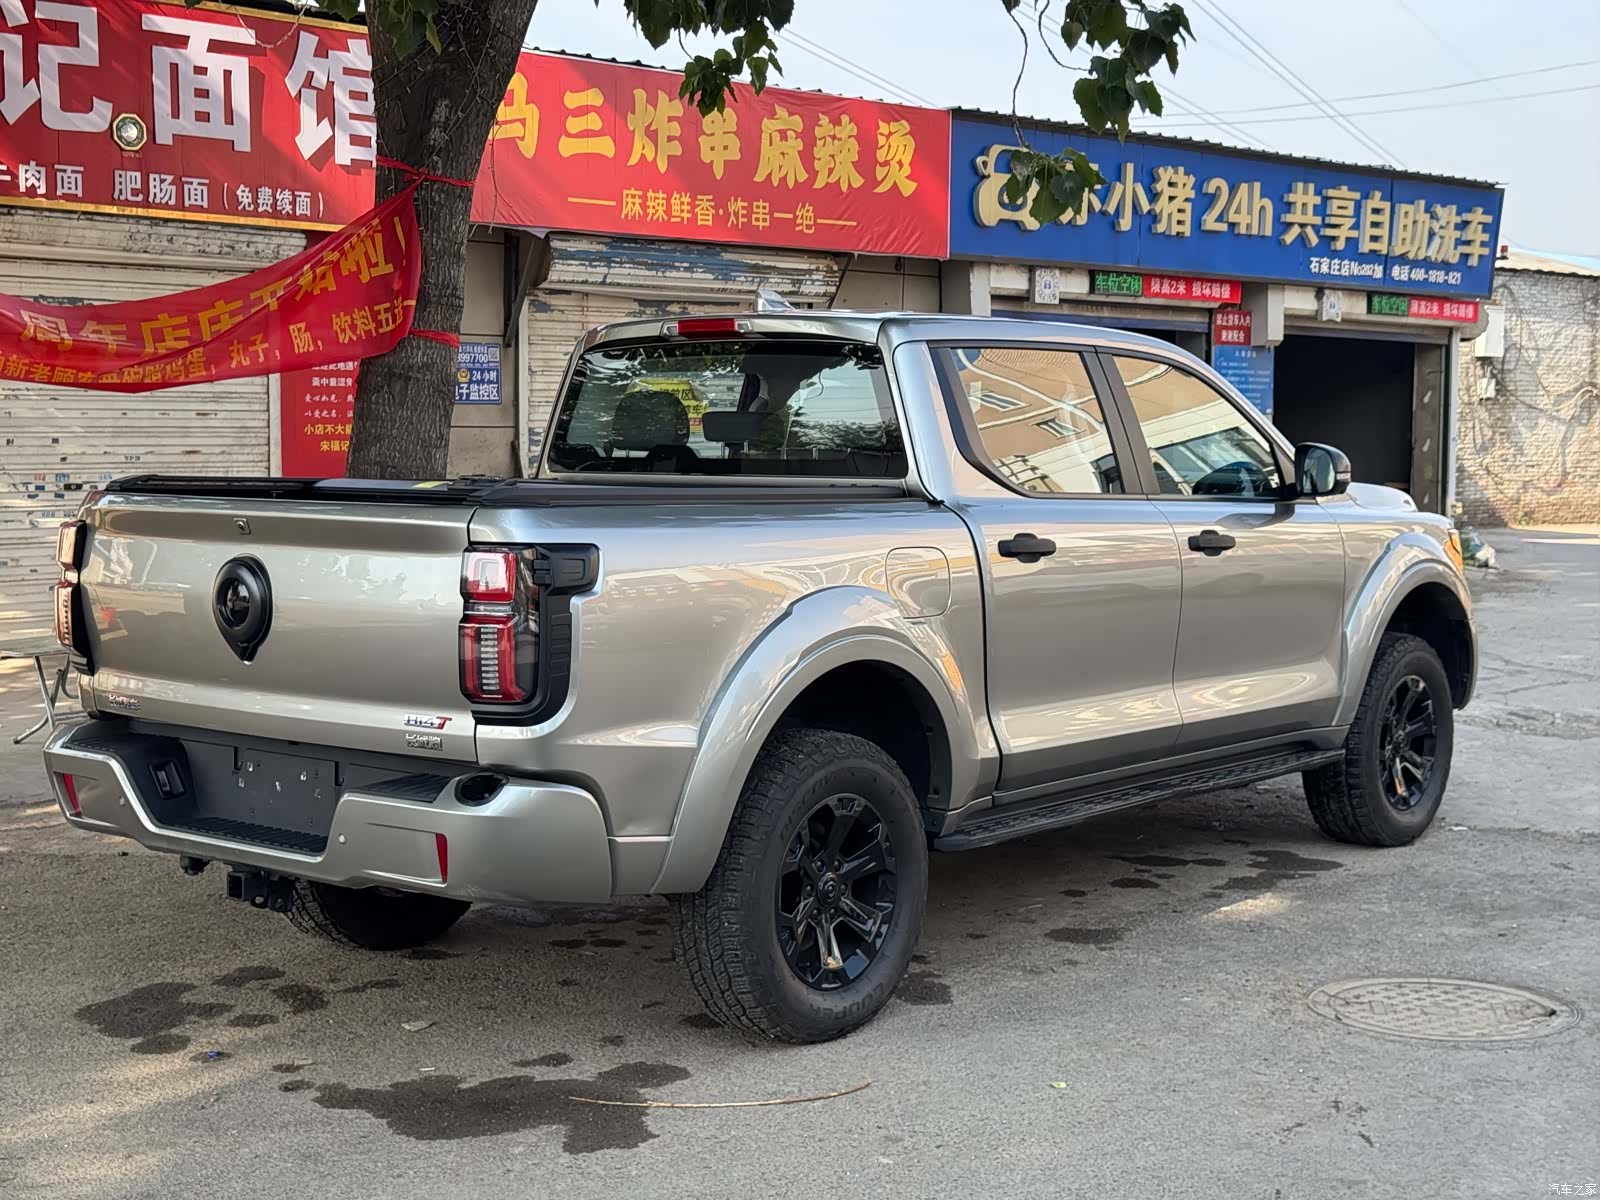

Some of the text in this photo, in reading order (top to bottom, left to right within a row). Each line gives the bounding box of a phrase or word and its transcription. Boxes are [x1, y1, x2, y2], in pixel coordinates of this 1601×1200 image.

[113, 169, 209, 208] 肥肠面
[1201, 177, 1273, 237] 24h
[1280, 181, 1492, 267] 共享自助洗车
